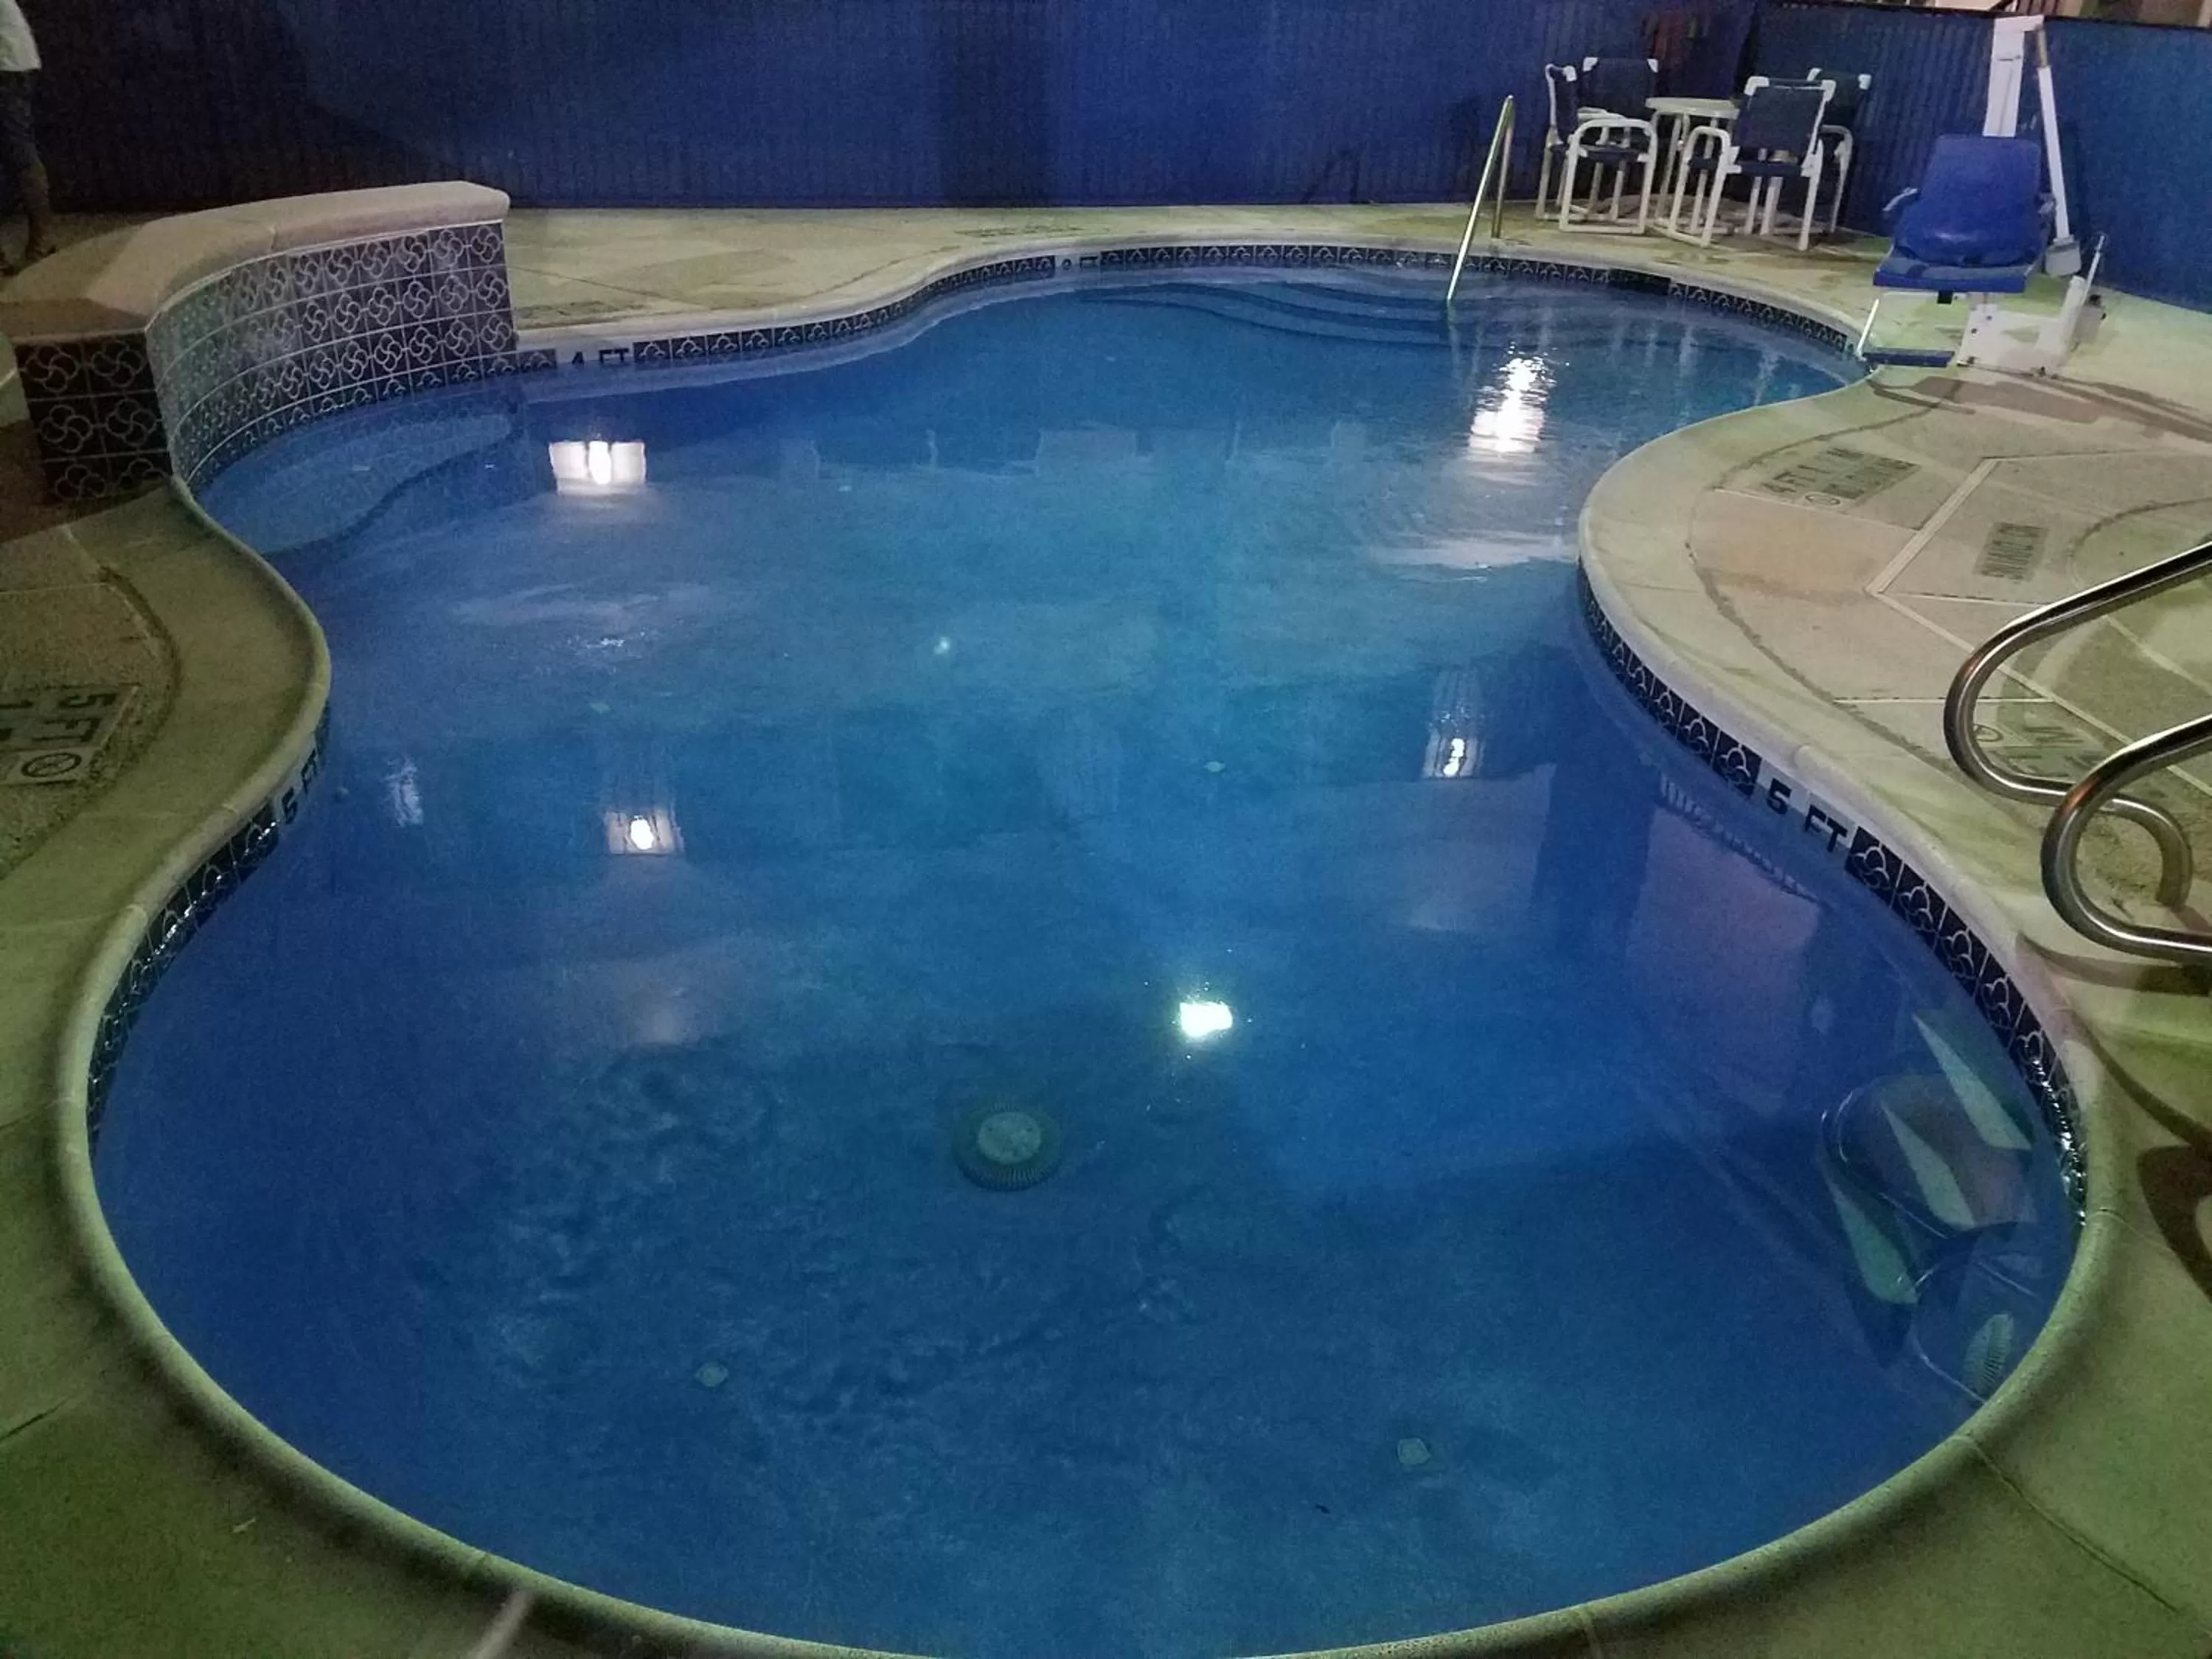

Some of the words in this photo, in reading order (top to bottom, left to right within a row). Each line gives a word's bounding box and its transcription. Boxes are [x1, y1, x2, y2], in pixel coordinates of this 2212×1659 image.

[599, 347, 629, 364] FT
[282, 787, 298, 824] 5
[301, 748, 318, 796] FT
[1767, 778, 1792, 815] 5
[1805, 804, 1848, 853] FT
